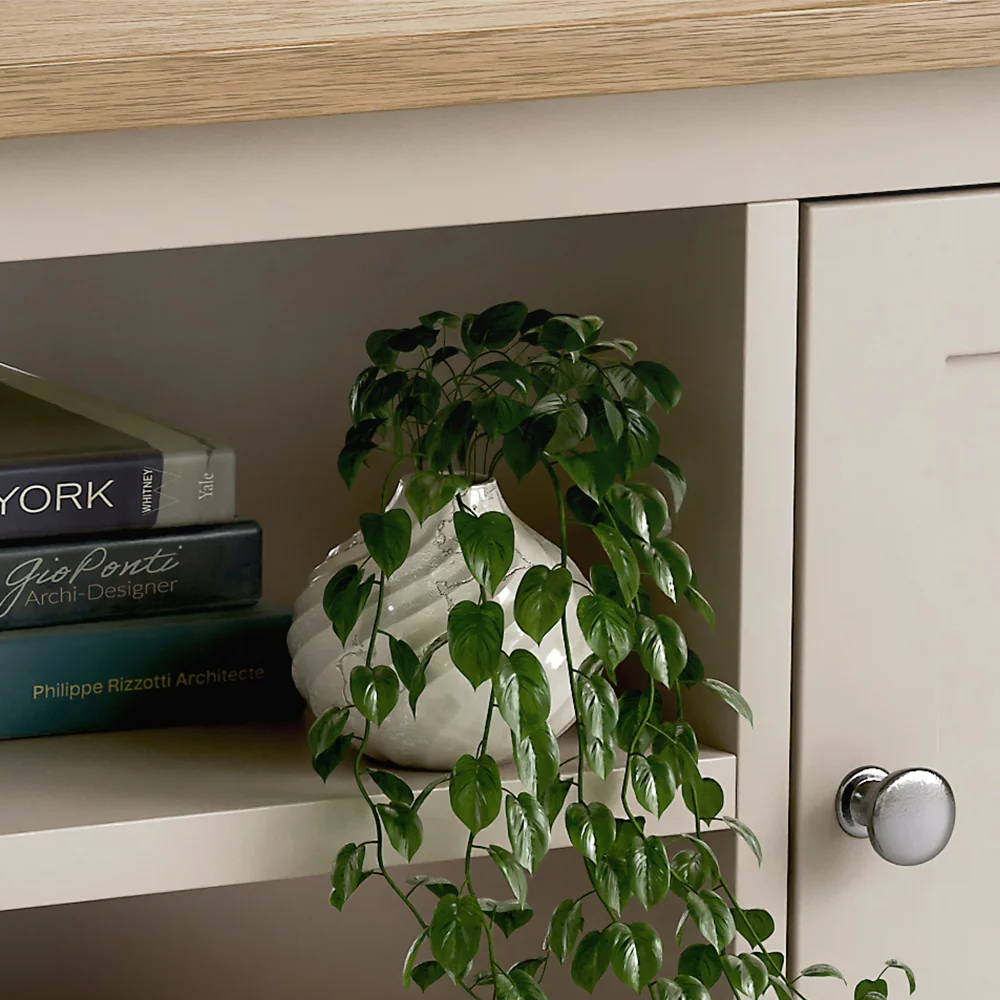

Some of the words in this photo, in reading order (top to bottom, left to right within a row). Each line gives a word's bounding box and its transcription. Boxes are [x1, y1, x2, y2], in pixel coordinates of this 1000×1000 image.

[141, 467, 154, 515] WHITNEY
[198, 472, 215, 501] Yale
[24, 577, 179, 607] Archi-Designer
[32, 681, 104, 700] Philippe
[108, 672, 171, 694] Rizzotti
[175, 665, 265, 688] Architecte
